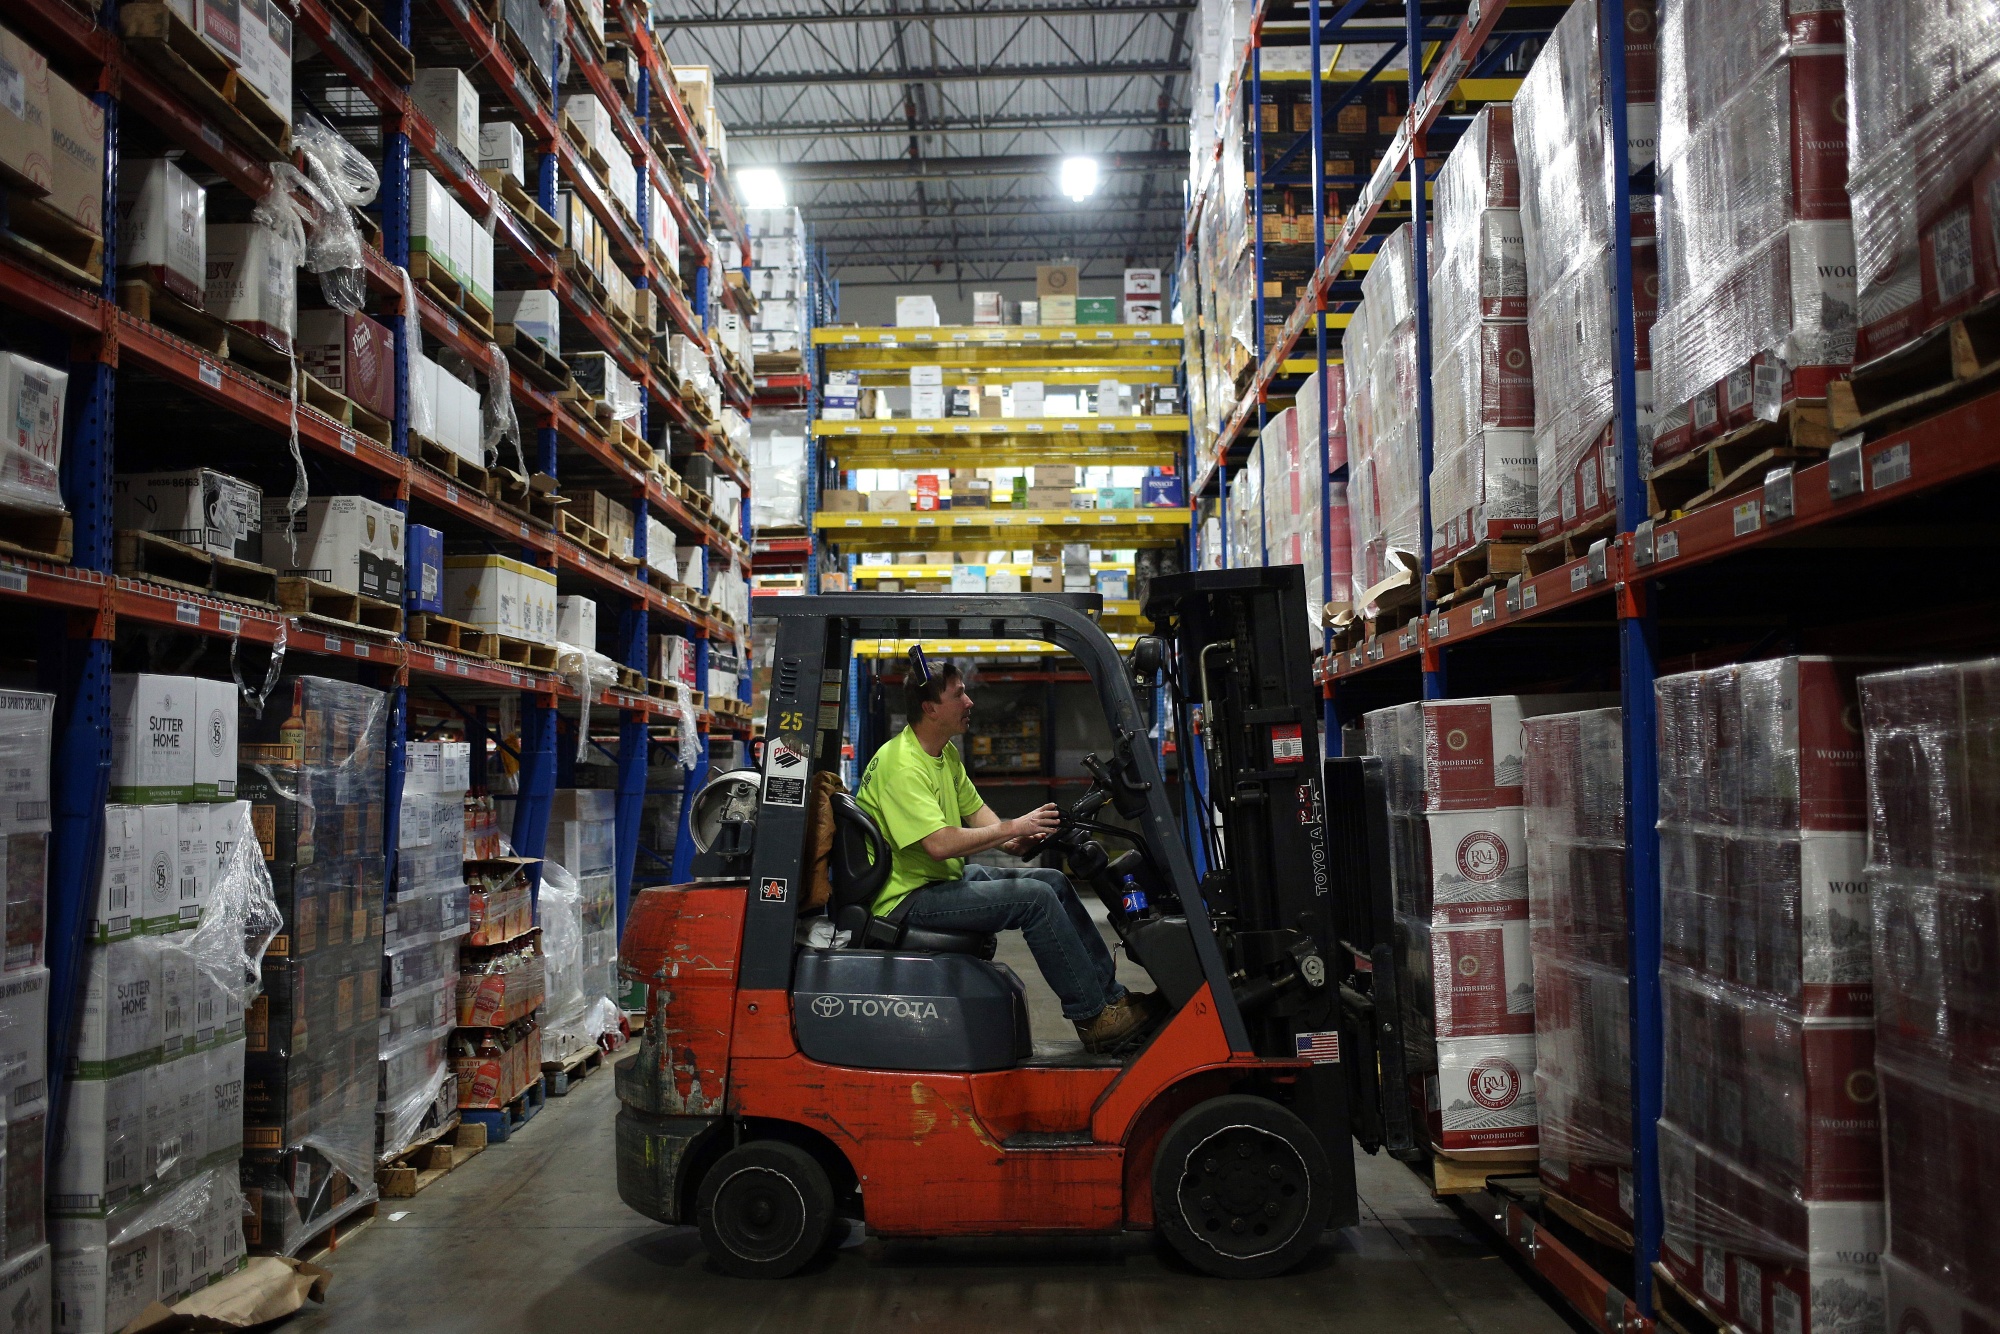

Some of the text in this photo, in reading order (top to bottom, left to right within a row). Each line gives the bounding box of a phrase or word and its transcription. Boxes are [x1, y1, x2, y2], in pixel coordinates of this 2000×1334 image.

[1624, 42, 1655, 51] ODBRI
[149, 715, 184, 733] SUTTER
[779, 711, 803, 731] 25
[153, 733, 180, 748] HOME
[1437, 757, 1484, 767] OODBRIDGE
[239, 783, 268, 791] aker's
[1309, 826, 1328, 897] TOYOTA
[1457, 904, 1513, 914] WOODBRIDGE
[117, 979, 151, 1000] SUTTER
[121, 997, 147, 1016] HOME
[848, 999, 939, 1019] TOYOTA
[457, 1068, 476, 1082] uby
[214, 1080, 242, 1100] SUTTER
[1482, 1075, 1506, 1092] RM
[1820, 1119, 1879, 1129] WOODBRI
[1470, 1131, 1524, 1141] WOODBRIDGE
